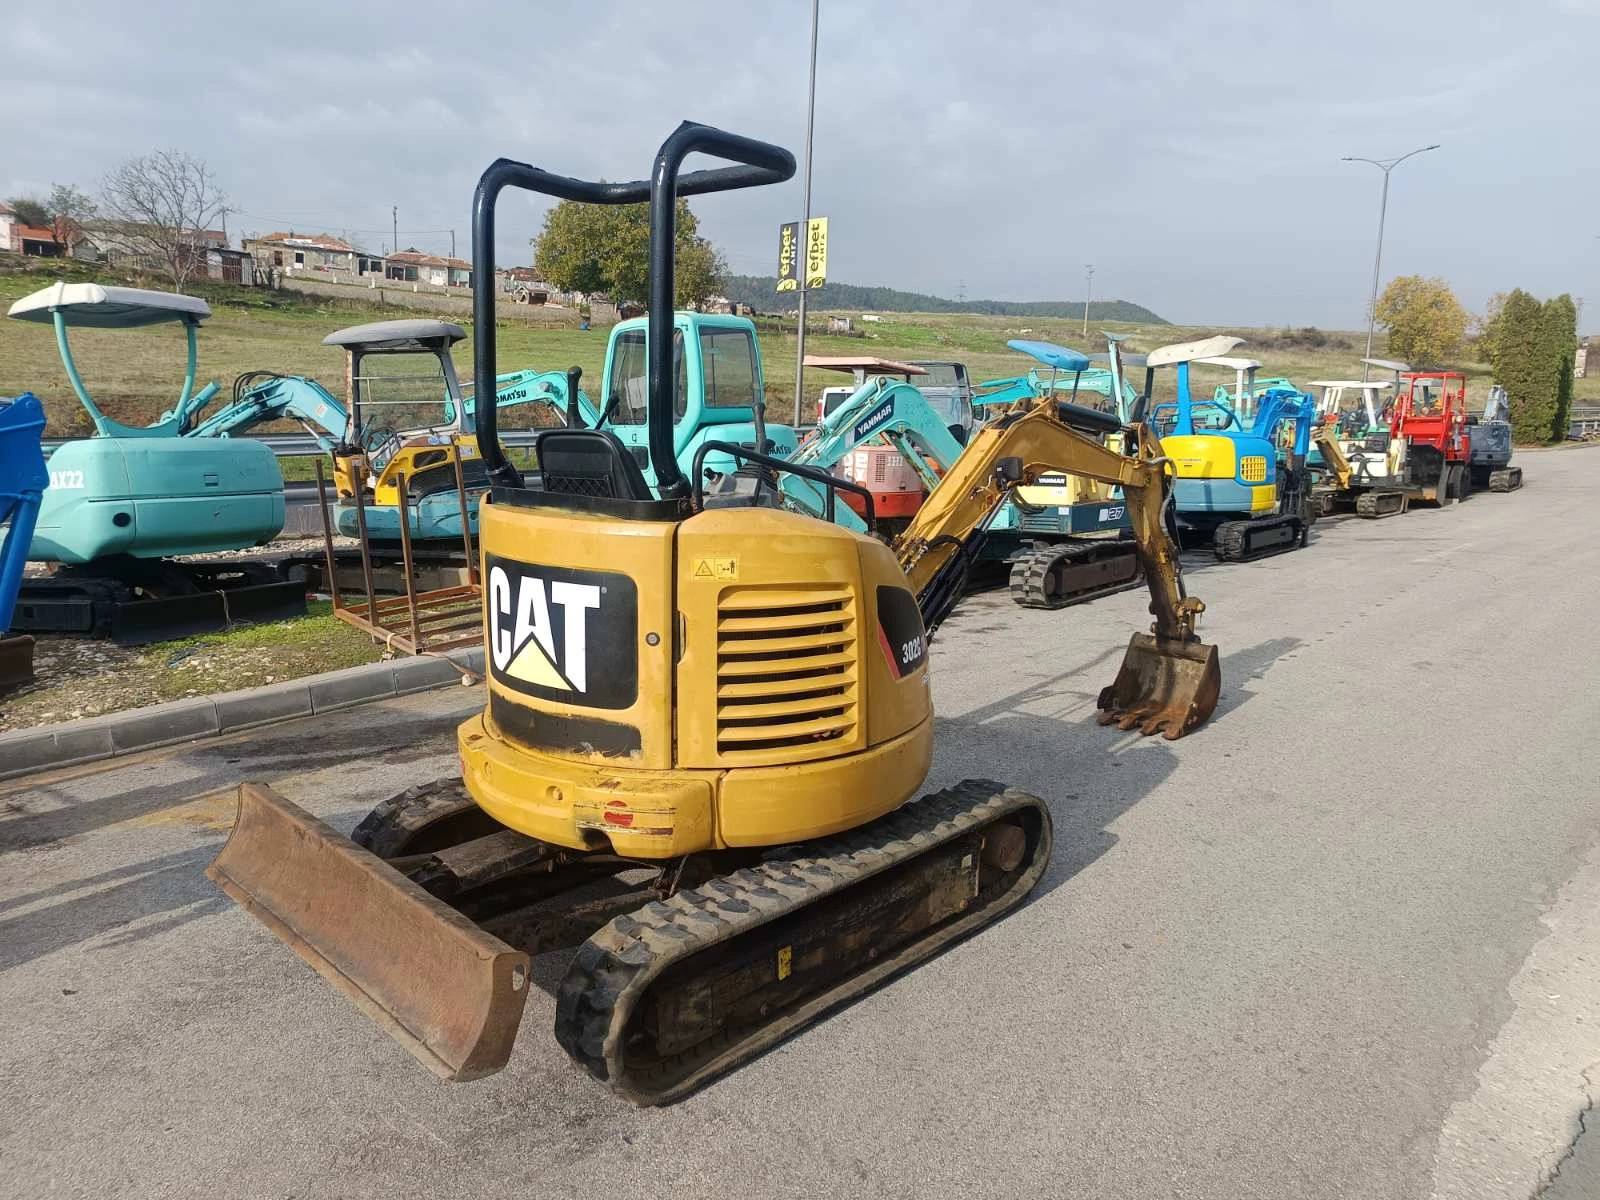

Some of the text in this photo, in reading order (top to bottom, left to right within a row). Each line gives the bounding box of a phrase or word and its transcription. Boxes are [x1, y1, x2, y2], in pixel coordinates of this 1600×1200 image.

[780, 227, 791, 277] efbet
[810, 223, 820, 272] efbet
[858, 404, 892, 435] YANMAR
[490, 566, 600, 693] CAT
